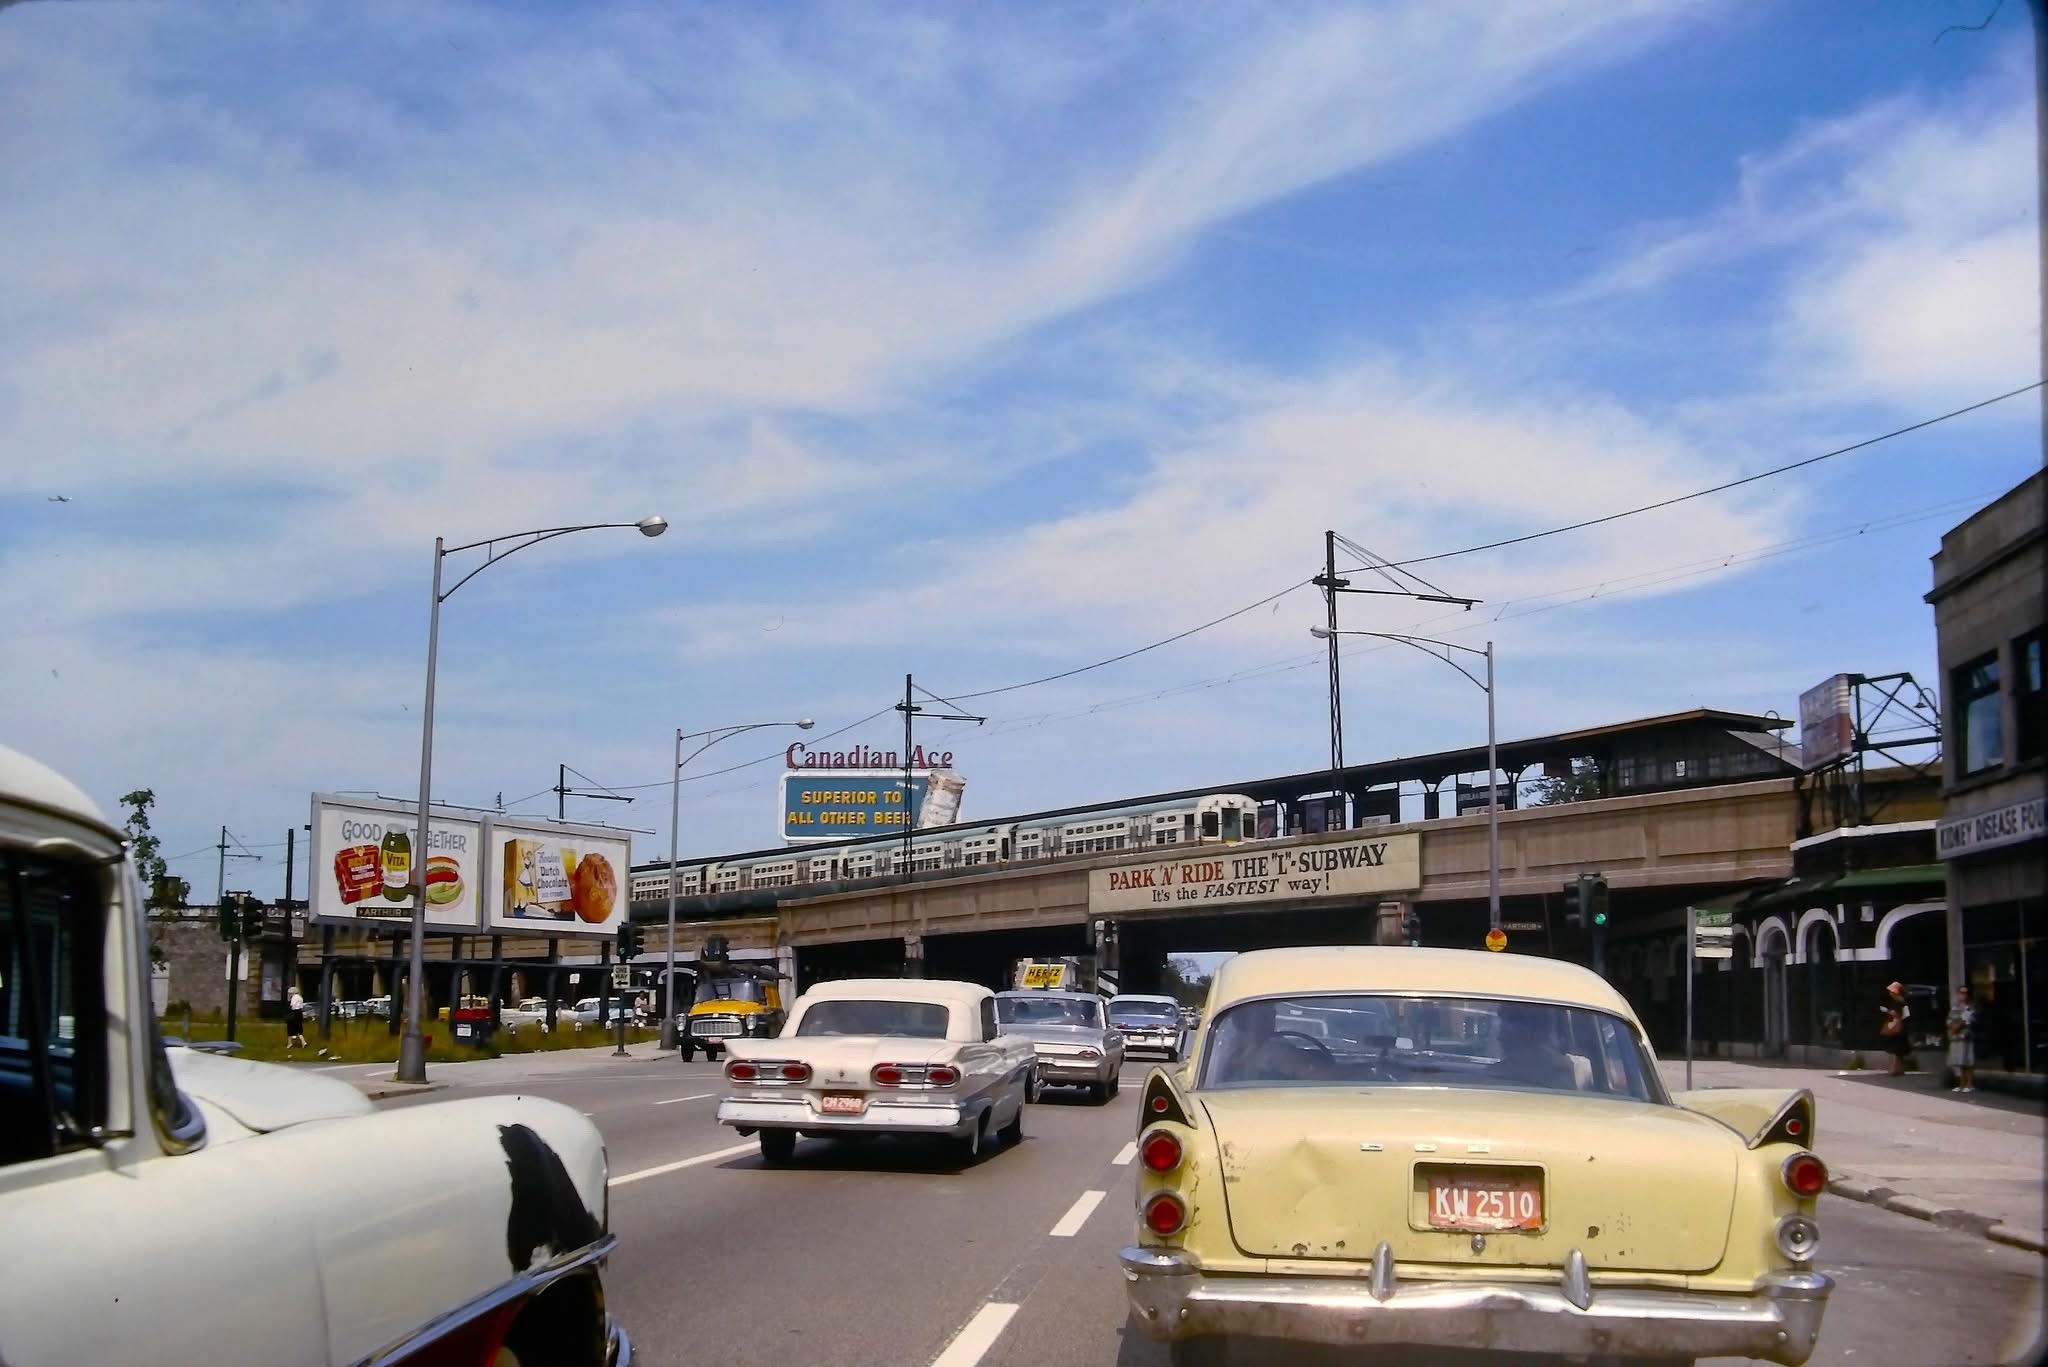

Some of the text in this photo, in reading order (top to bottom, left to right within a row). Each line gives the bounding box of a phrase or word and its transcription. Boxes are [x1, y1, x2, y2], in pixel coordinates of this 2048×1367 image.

[786, 742, 953, 770] Canadian Ace
[801, 790, 902, 804] SUPERIOR TO
[787, 811, 912, 825] ALL OTHER BEER
[1940, 819, 1973, 850] KIDNEY
[1976, 807, 2017, 842] DISEASE
[342, 819, 467, 853] GOOD TGETHER
[1109, 868, 1156, 891] PARK
[1181, 860, 1225, 884] RIDE
[1232, 856, 1269, 880] THE
[1152, 889, 1170, 902] It's
[1176, 887, 1198, 900] the
[1204, 878, 1280, 898] FASTEST
[364, 908, 402, 917] ARTHUR
[1028, 968, 1060, 977] HERTZ
[1435, 1187, 1534, 1218] KW 2510
